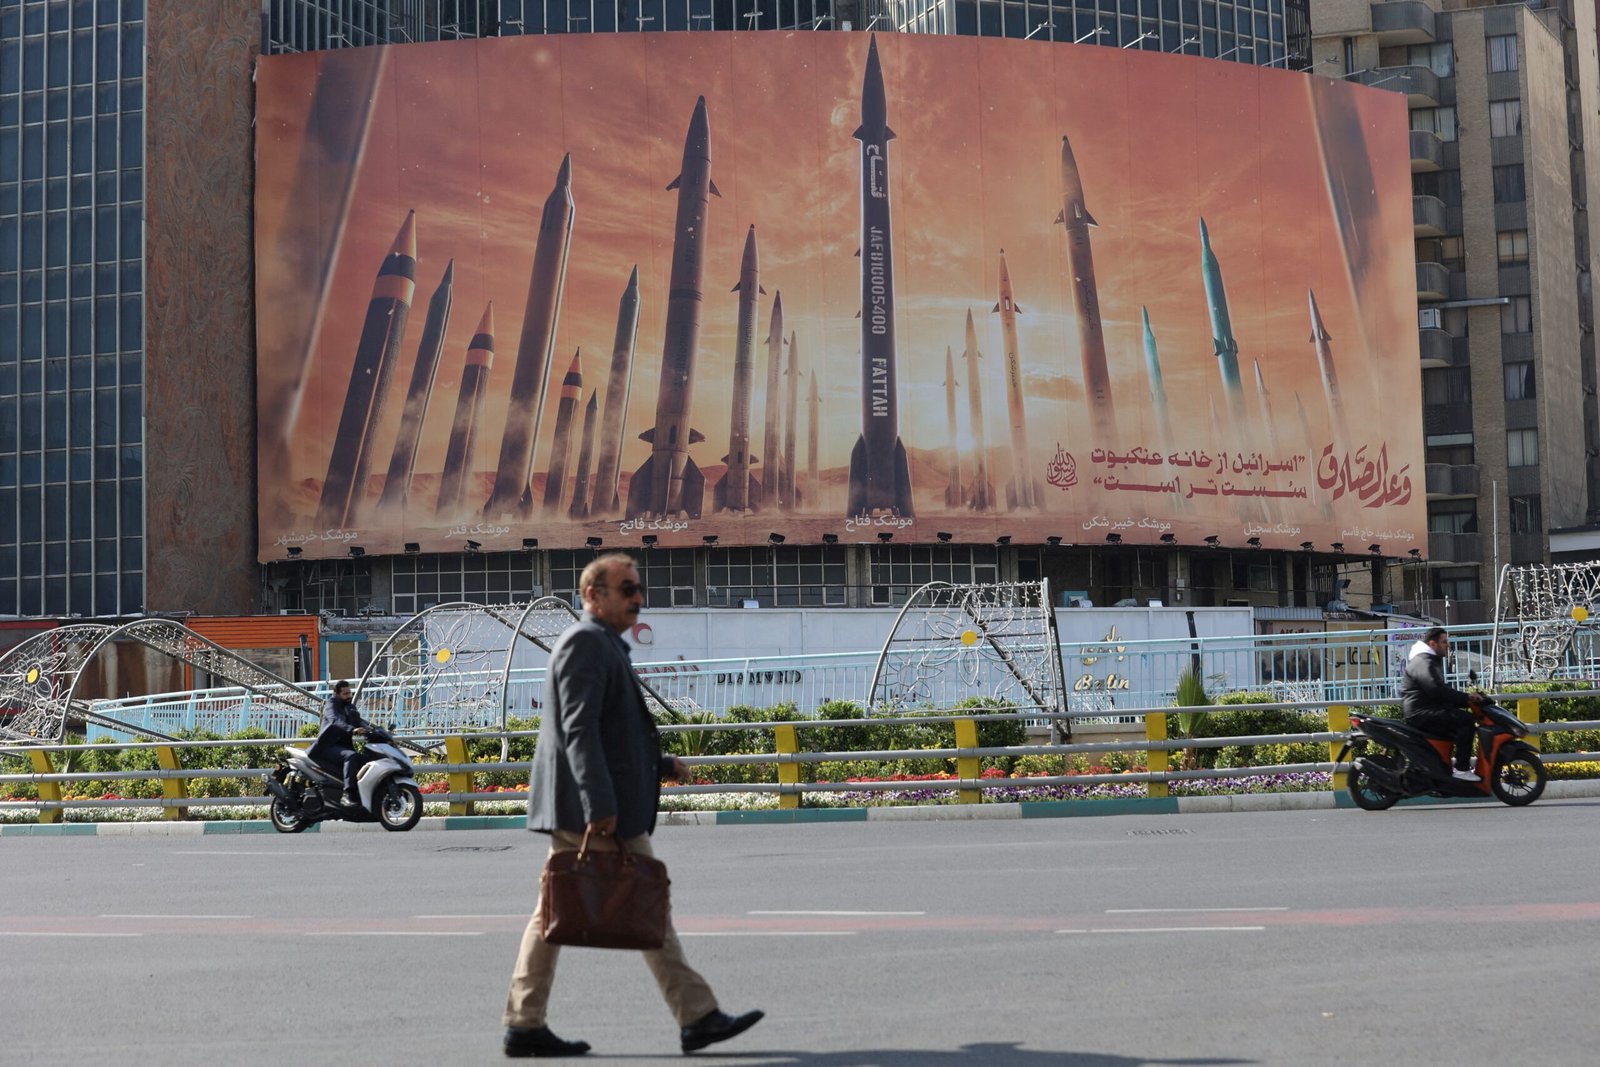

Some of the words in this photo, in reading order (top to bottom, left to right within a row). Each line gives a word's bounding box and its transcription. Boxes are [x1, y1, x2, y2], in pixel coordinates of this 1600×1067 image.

[872, 358, 888, 417] FATTAH
[1091, 446, 1163, 470] عنکبوت
[1168, 450, 1212, 468] خانه
[1216, 451, 1228, 474] از
[1186, 479, 1218, 498] تر
[619, 517, 645, 536] فاتح
[648, 517, 688, 533] موشک
[845, 514, 871, 532] فتاح
[873, 514, 913, 529] موشک
[1082, 515, 1109, 530] شکن
[1111, 517, 1135, 530] خیبر
[1137, 517, 1171, 533] موشک
[1243, 521, 1272, 536] سجیل
[444, 523, 467, 538] قدر
[470, 523, 510, 537] موشک
[1272, 523, 1301, 537] موشک
